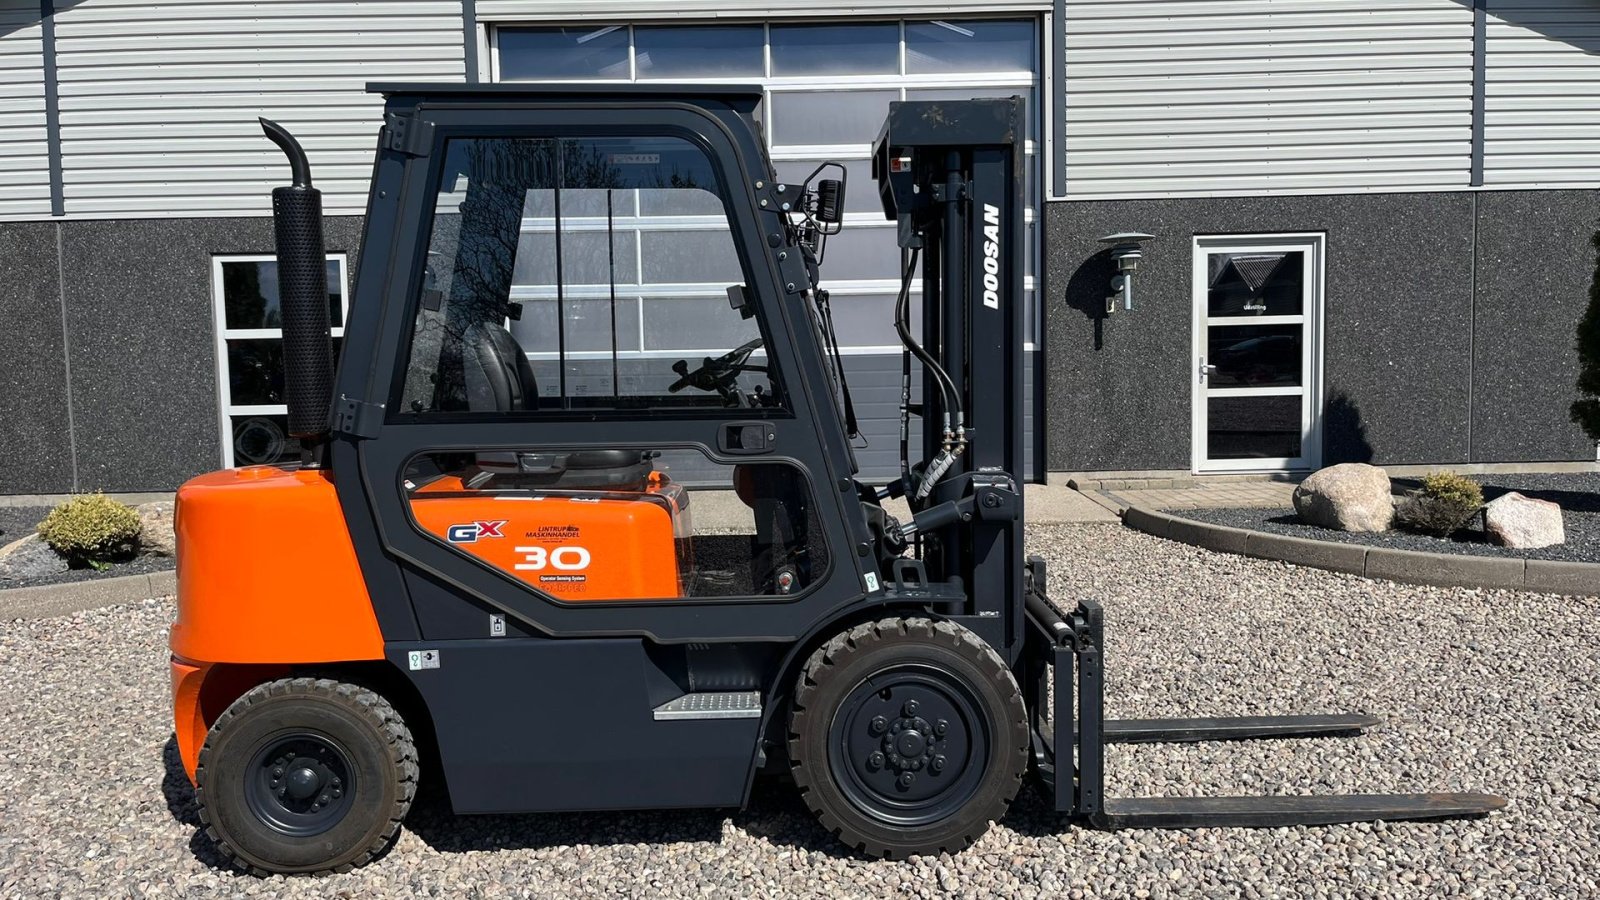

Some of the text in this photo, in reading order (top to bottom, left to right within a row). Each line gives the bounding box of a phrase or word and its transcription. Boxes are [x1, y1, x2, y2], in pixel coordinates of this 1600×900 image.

[983, 203, 999, 309] DOOSAN
[447, 519, 509, 544] GX
[514, 546, 591, 570] 30
